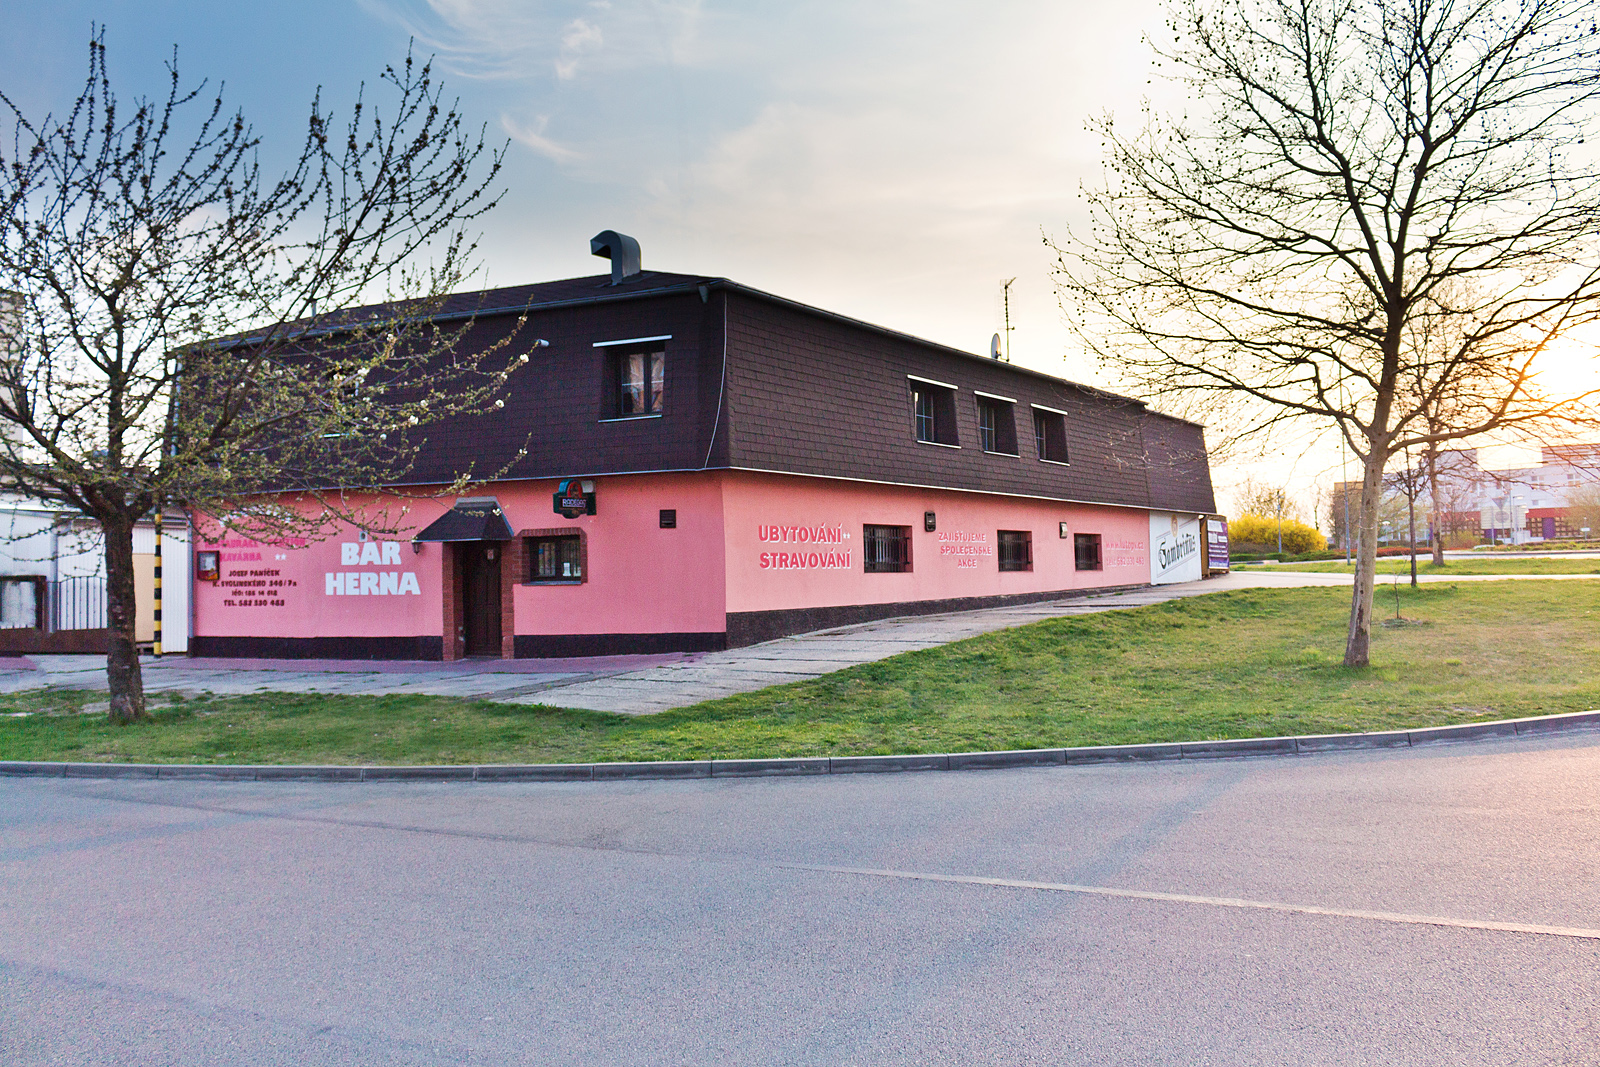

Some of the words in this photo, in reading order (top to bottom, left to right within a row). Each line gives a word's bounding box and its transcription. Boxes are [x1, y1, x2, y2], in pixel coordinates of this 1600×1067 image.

[758, 522, 843, 545] UBYTOVÁNÍ
[341, 541, 402, 566] BAR
[759, 547, 852, 570] STRAVOVÁNÍ
[940, 544, 992, 556] SPOLEČENSKÉ
[957, 558, 978, 569] AKCE
[228, 569, 248, 577] JOSEF
[325, 571, 421, 596] HERNA
[223, 599, 238, 607] TEL.
